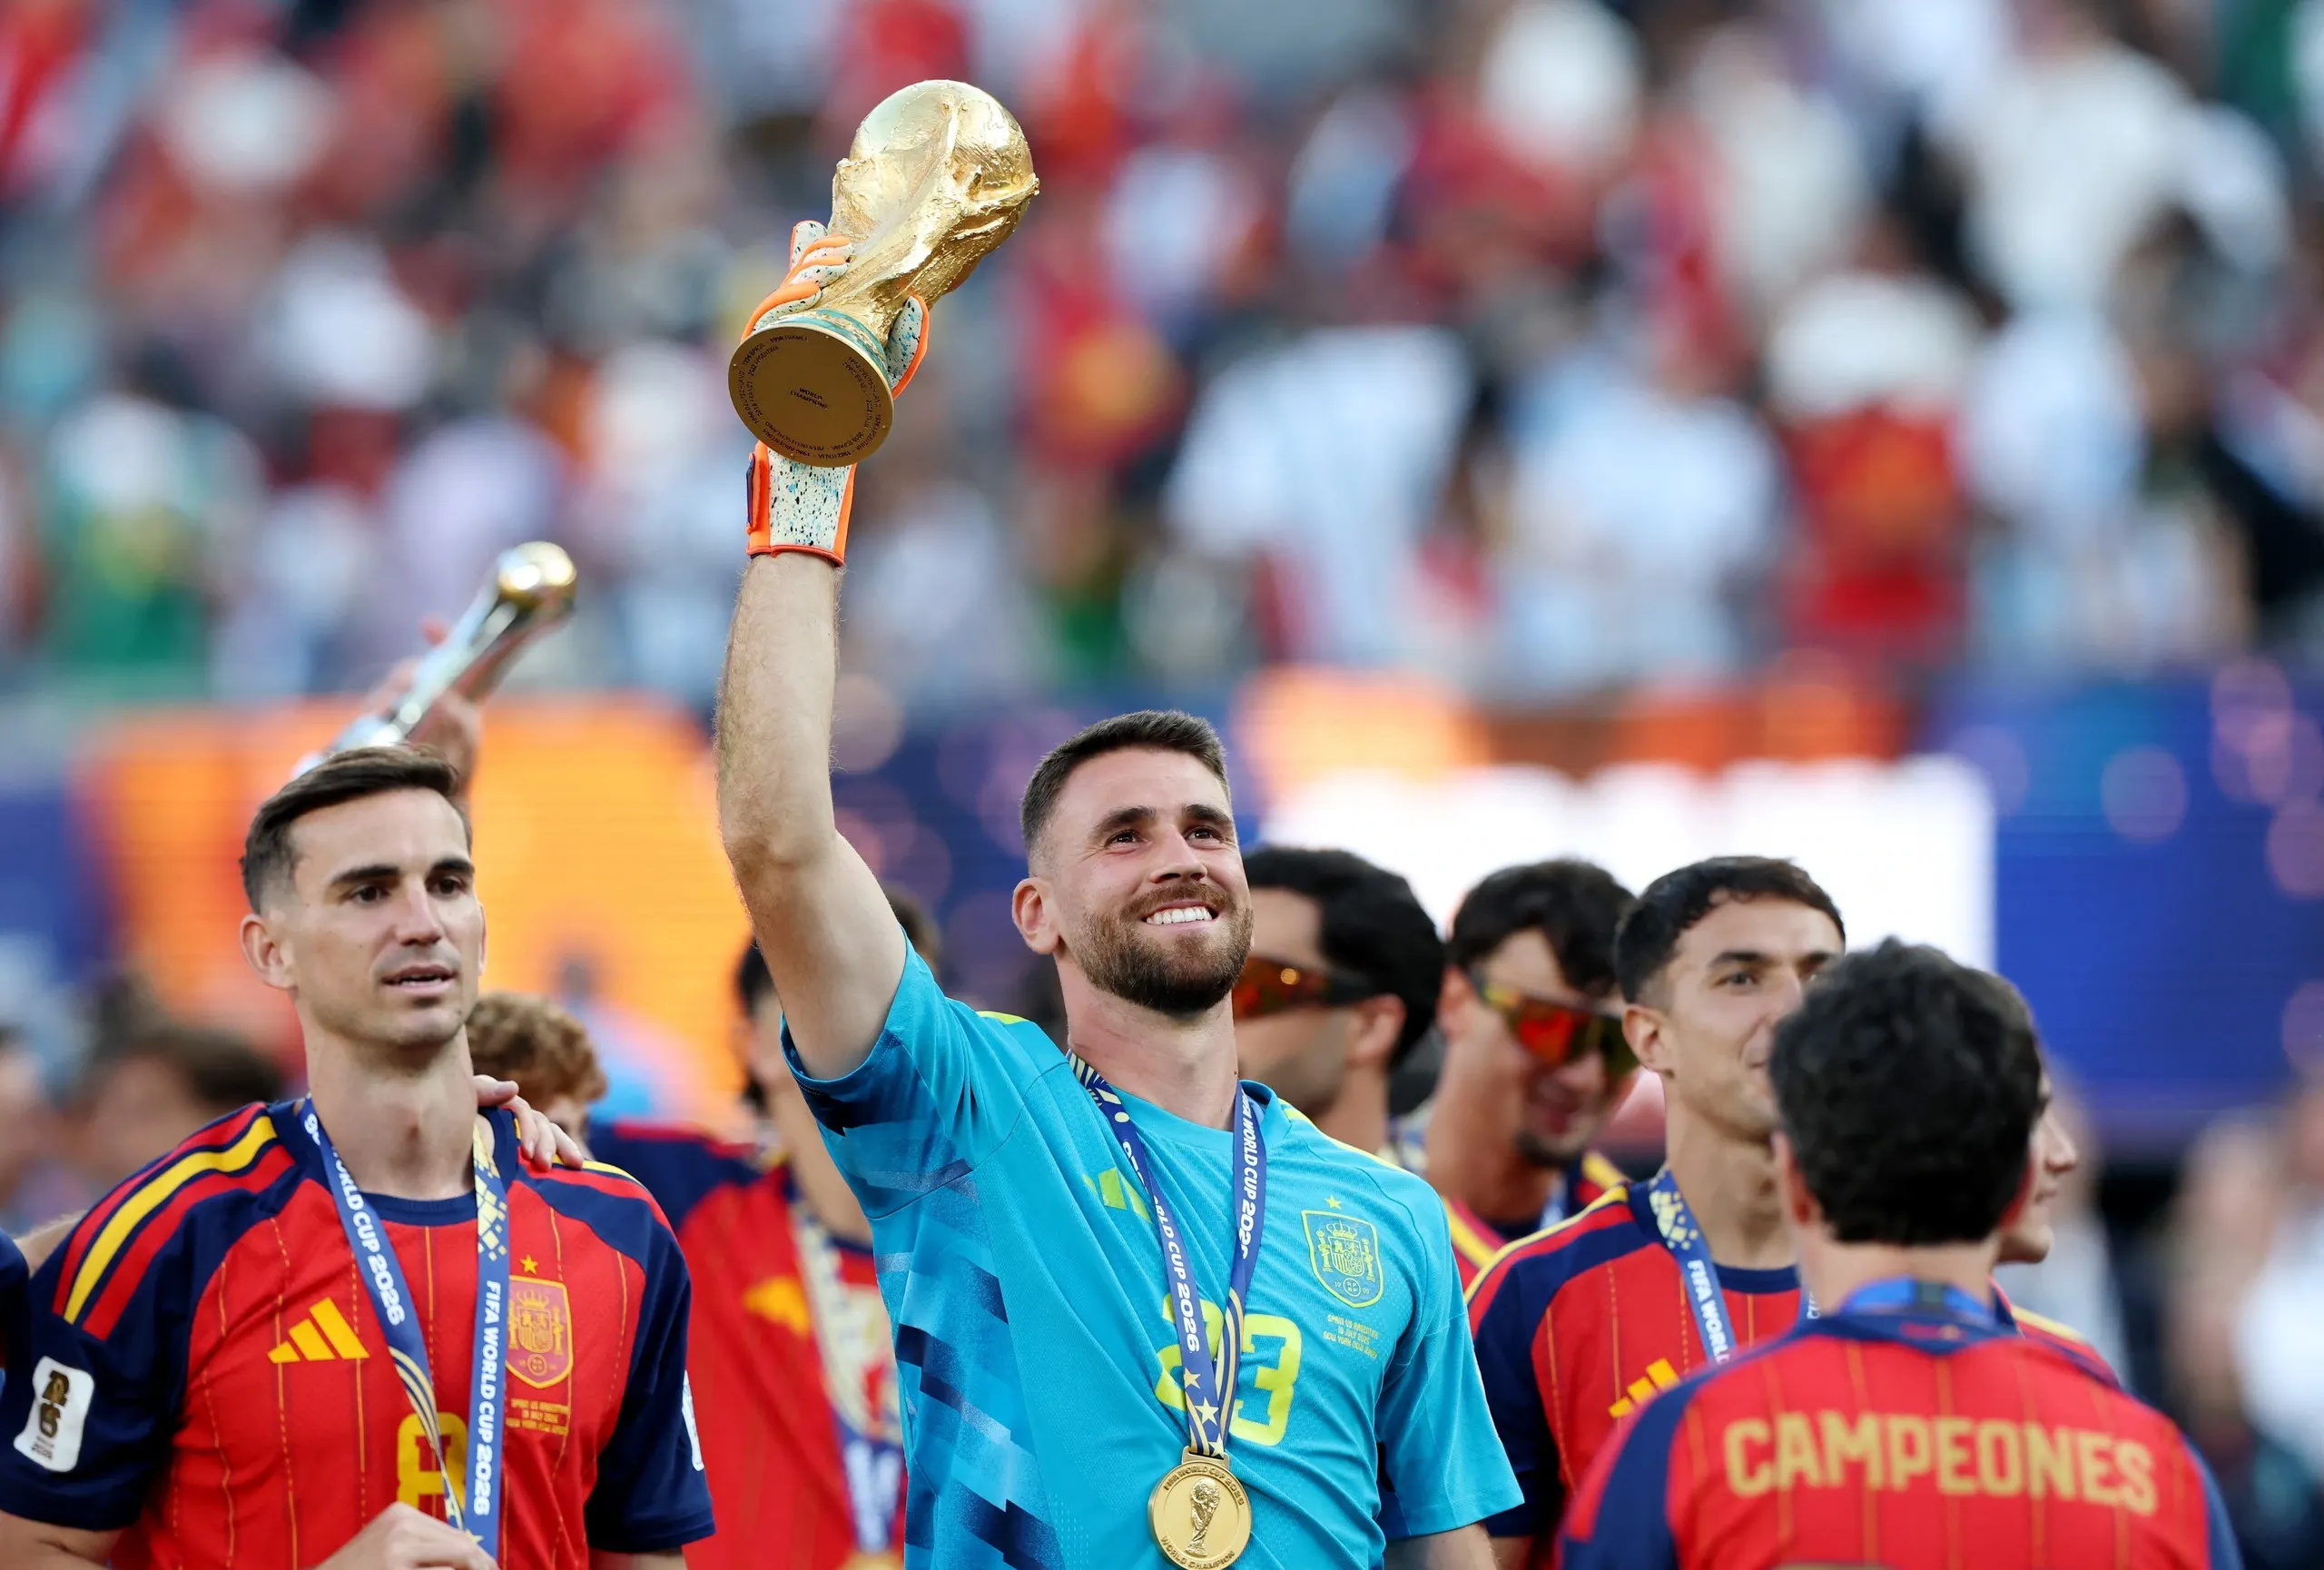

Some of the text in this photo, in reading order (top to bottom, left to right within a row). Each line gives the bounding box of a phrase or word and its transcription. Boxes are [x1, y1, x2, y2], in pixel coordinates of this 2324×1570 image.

[799, 387, 823, 400] WORLD
[1243, 1118, 1258, 1167] WORLD
[1244, 1166, 1258, 1201] CUP
[352, 1211, 380, 1253] CUP
[367, 1253, 406, 1327] 2026
[1687, 1259, 1714, 1302] FIFA
[1167, 1239, 1187, 1281] CUP
[1177, 1280, 1200, 1354] 2026
[1155, 1292, 1303, 1447] 23
[473, 1279, 501, 1516] FIFA WORLD CUP 2026
[1178, 1466, 1208, 1479] WORLD
[1208, 1466, 1226, 1480] CUP
[1722, 1409, 2157, 1516] CAMPEONES
[1161, 1535, 1236, 1570] WORLD CHAMPION
